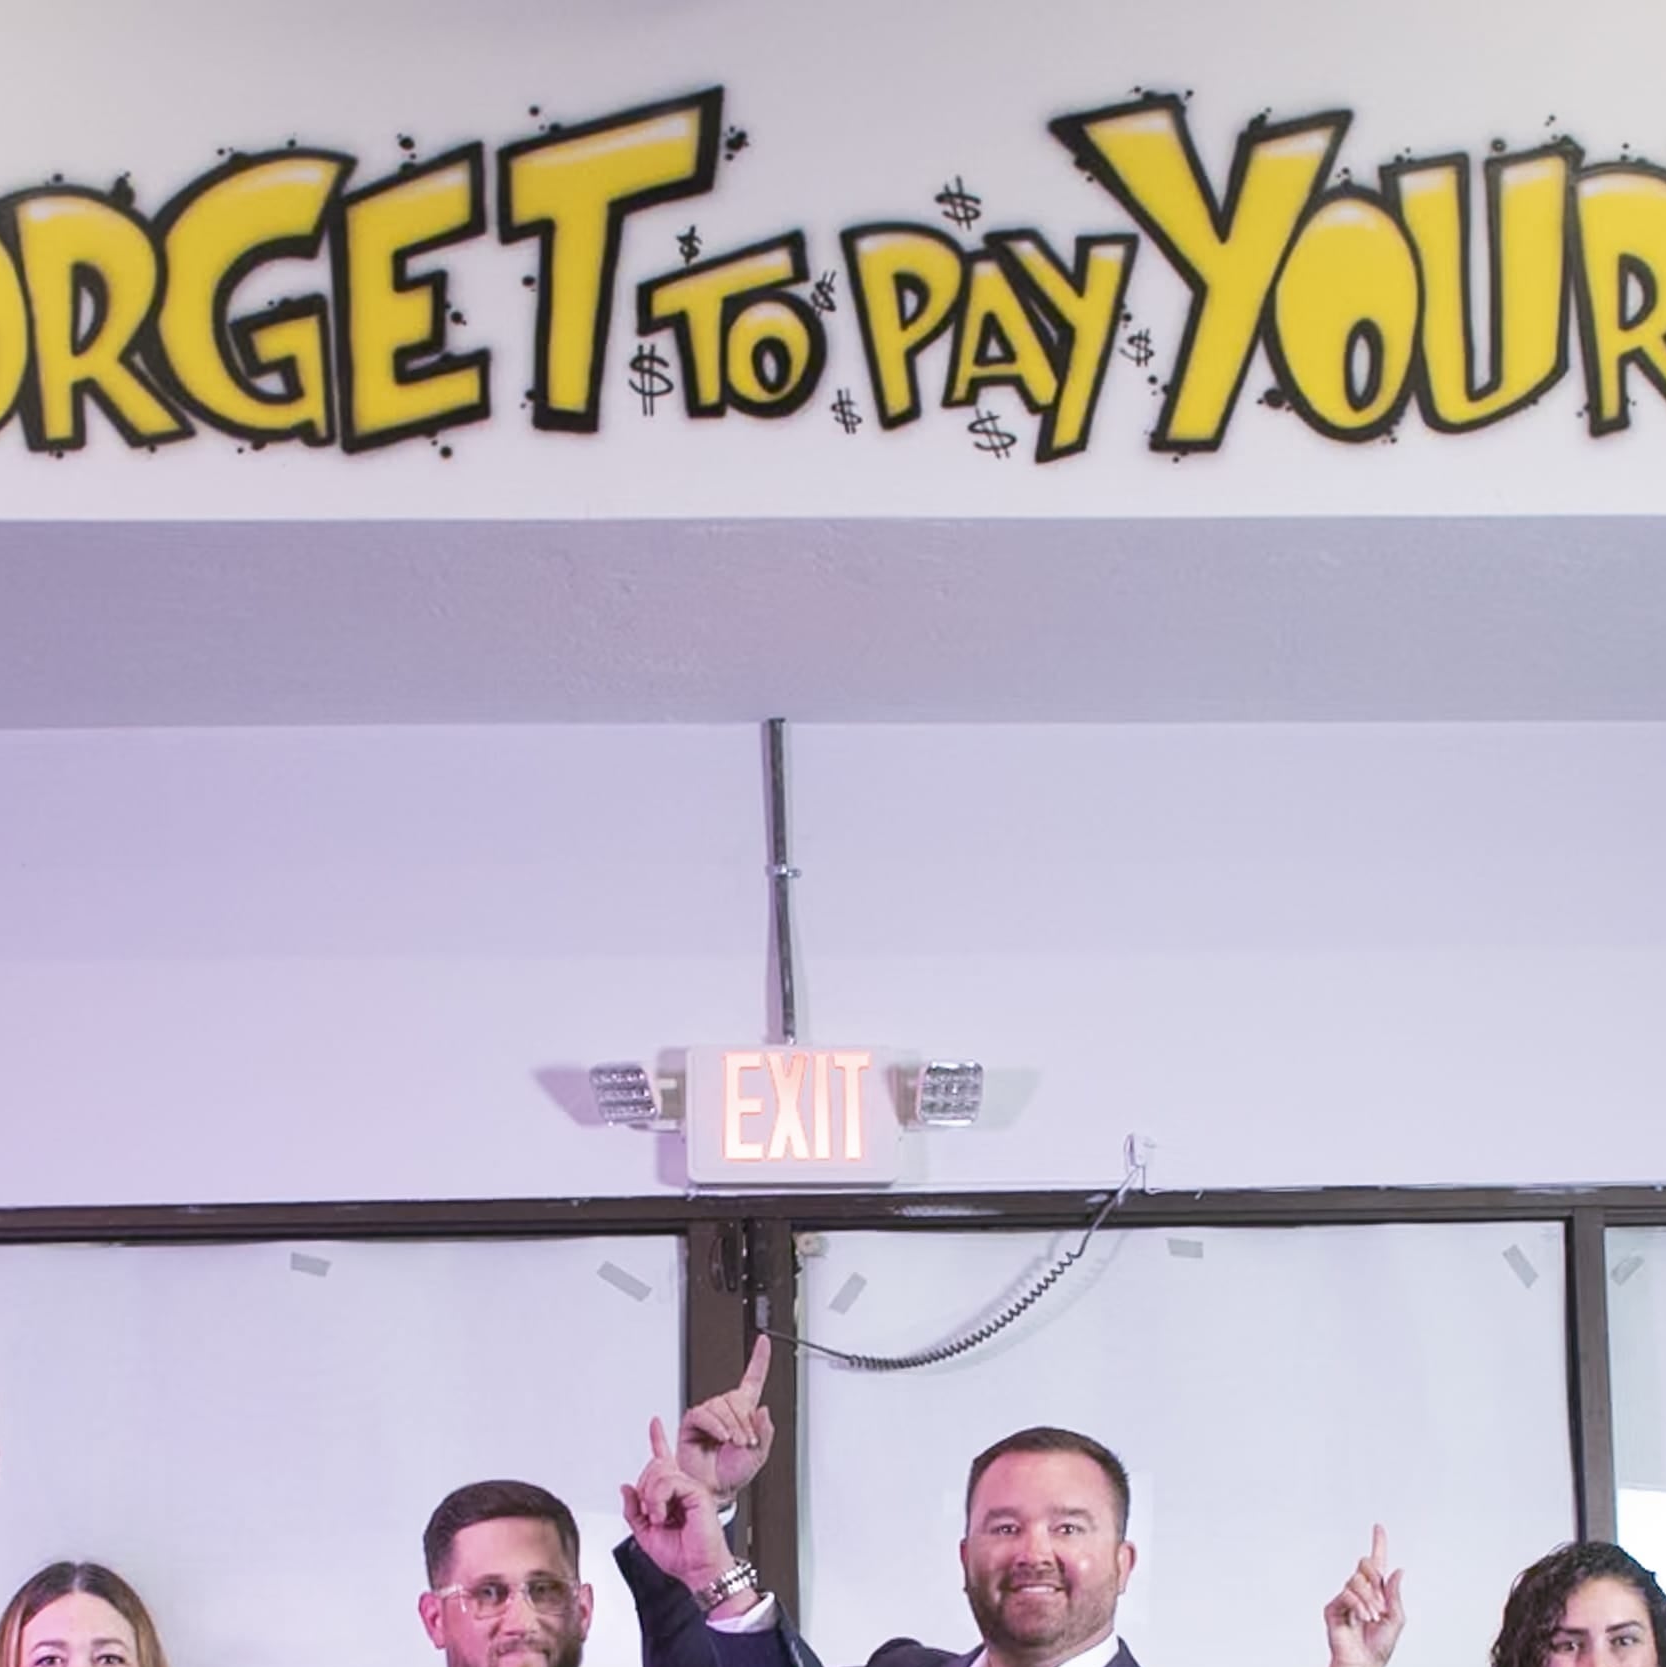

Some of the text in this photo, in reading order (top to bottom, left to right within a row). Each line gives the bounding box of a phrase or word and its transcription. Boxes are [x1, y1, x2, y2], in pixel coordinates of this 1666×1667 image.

[636, 230, 828, 419] TO
[840, 221, 1139, 463] PAY
[721, 1051, 871, 1161] EXIT
